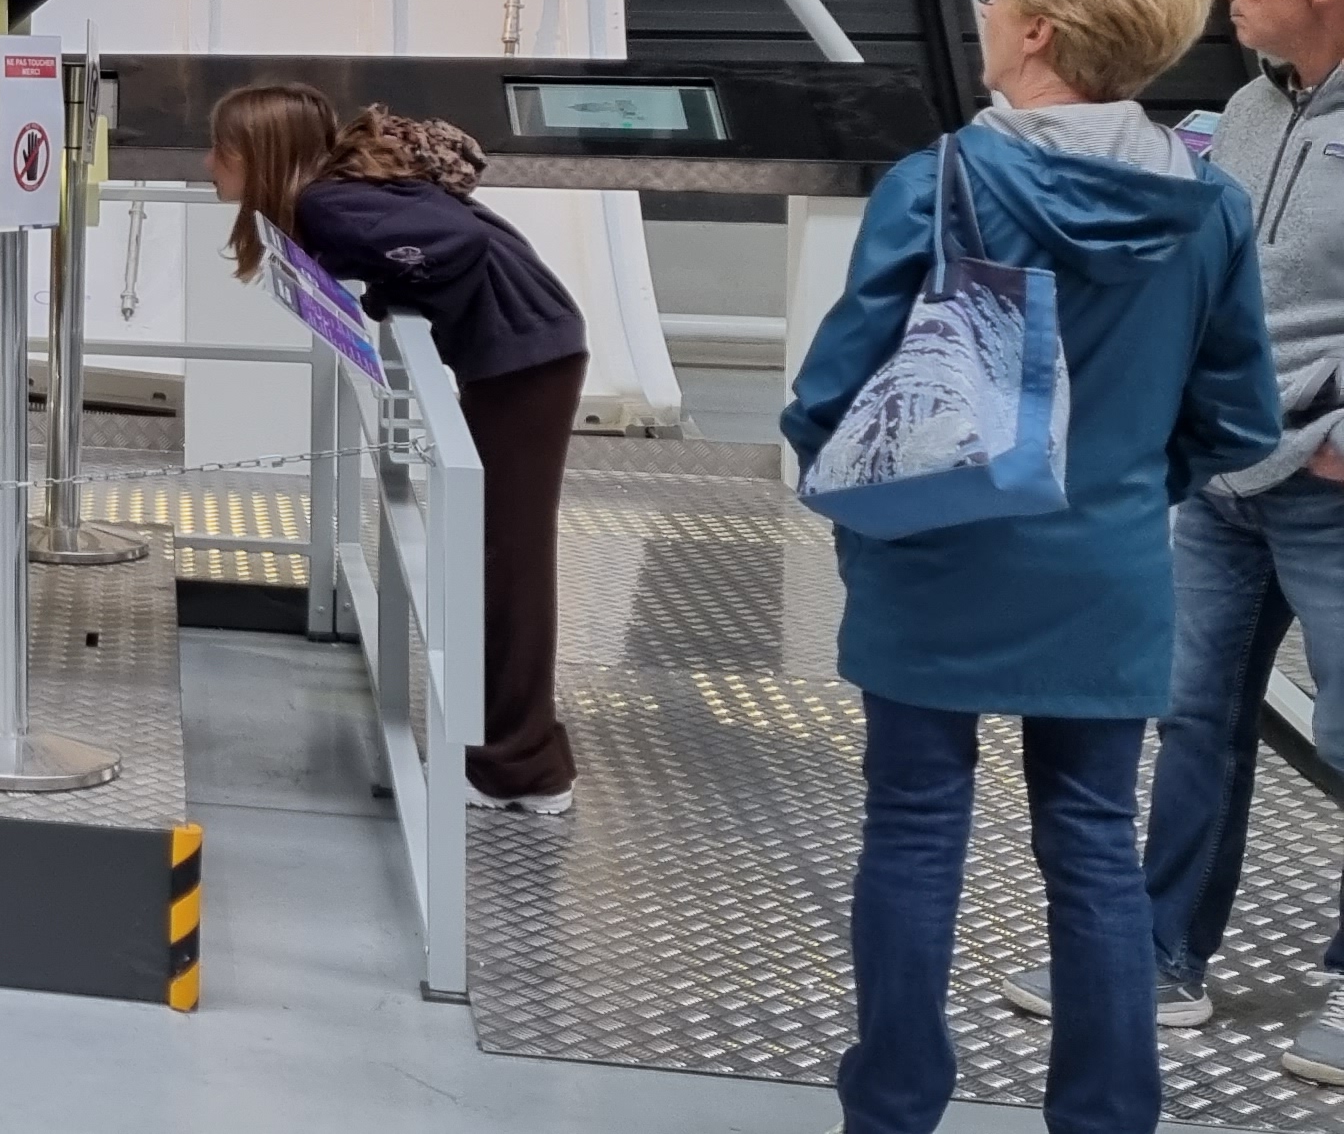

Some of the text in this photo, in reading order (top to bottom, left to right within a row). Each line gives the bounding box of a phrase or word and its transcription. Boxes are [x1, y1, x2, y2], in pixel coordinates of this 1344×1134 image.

[15, 58, 27, 66] PAS
[27, 58, 55, 67] TOUCHER
[22, 68, 41, 76] MERCI
